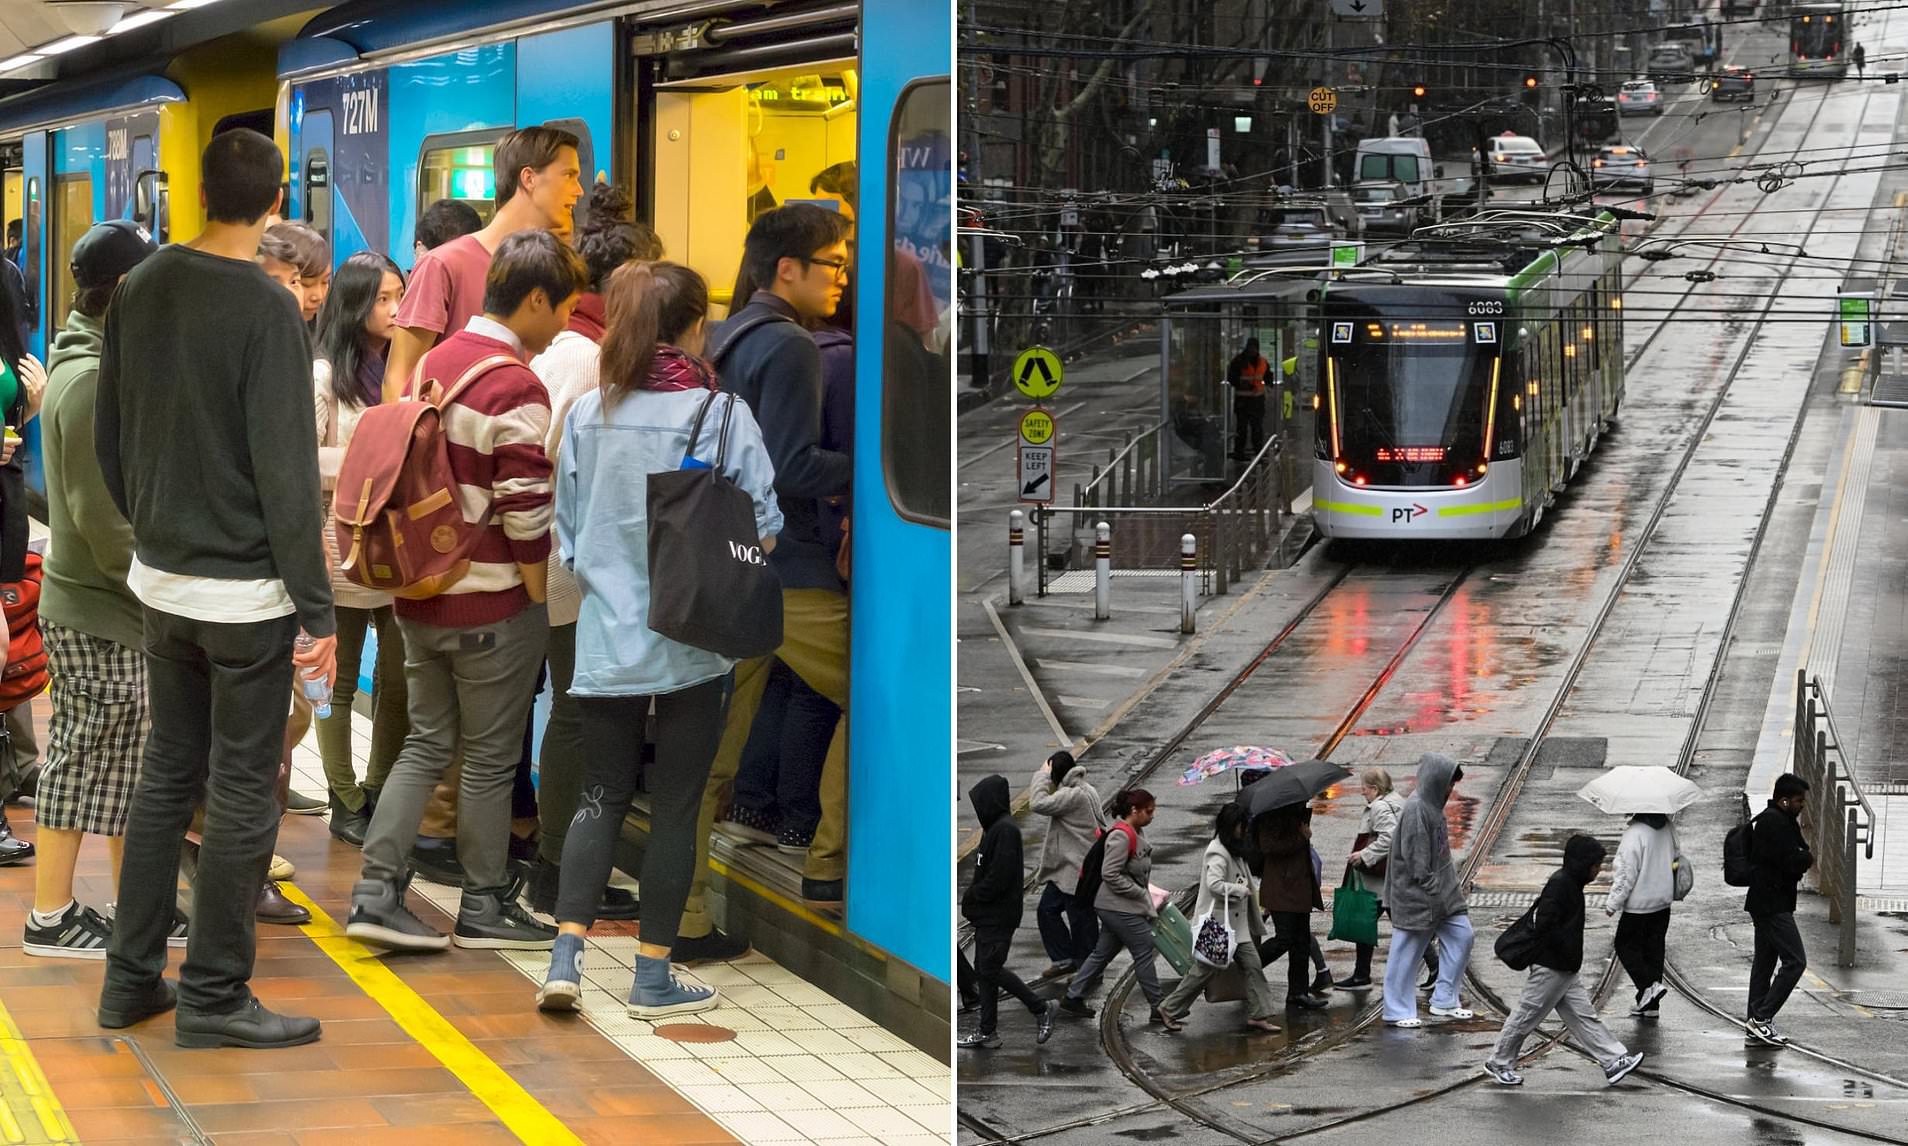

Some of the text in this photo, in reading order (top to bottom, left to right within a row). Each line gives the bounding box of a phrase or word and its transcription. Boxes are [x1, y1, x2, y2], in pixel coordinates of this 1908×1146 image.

[743, 86, 778, 100] am
[1311, 92, 1333, 101] CUT
[342, 88, 378, 135] 727M
[1312, 103, 1333, 112] OFF
[1468, 301, 1503, 315] 6083
[1024, 418, 1049, 428] SAFETY
[1028, 429, 1046, 438] ZONE
[1025, 452, 1048, 461] KEEP
[1025, 462, 1047, 471] LEFT
[728, 540, 767, 566] VOG
